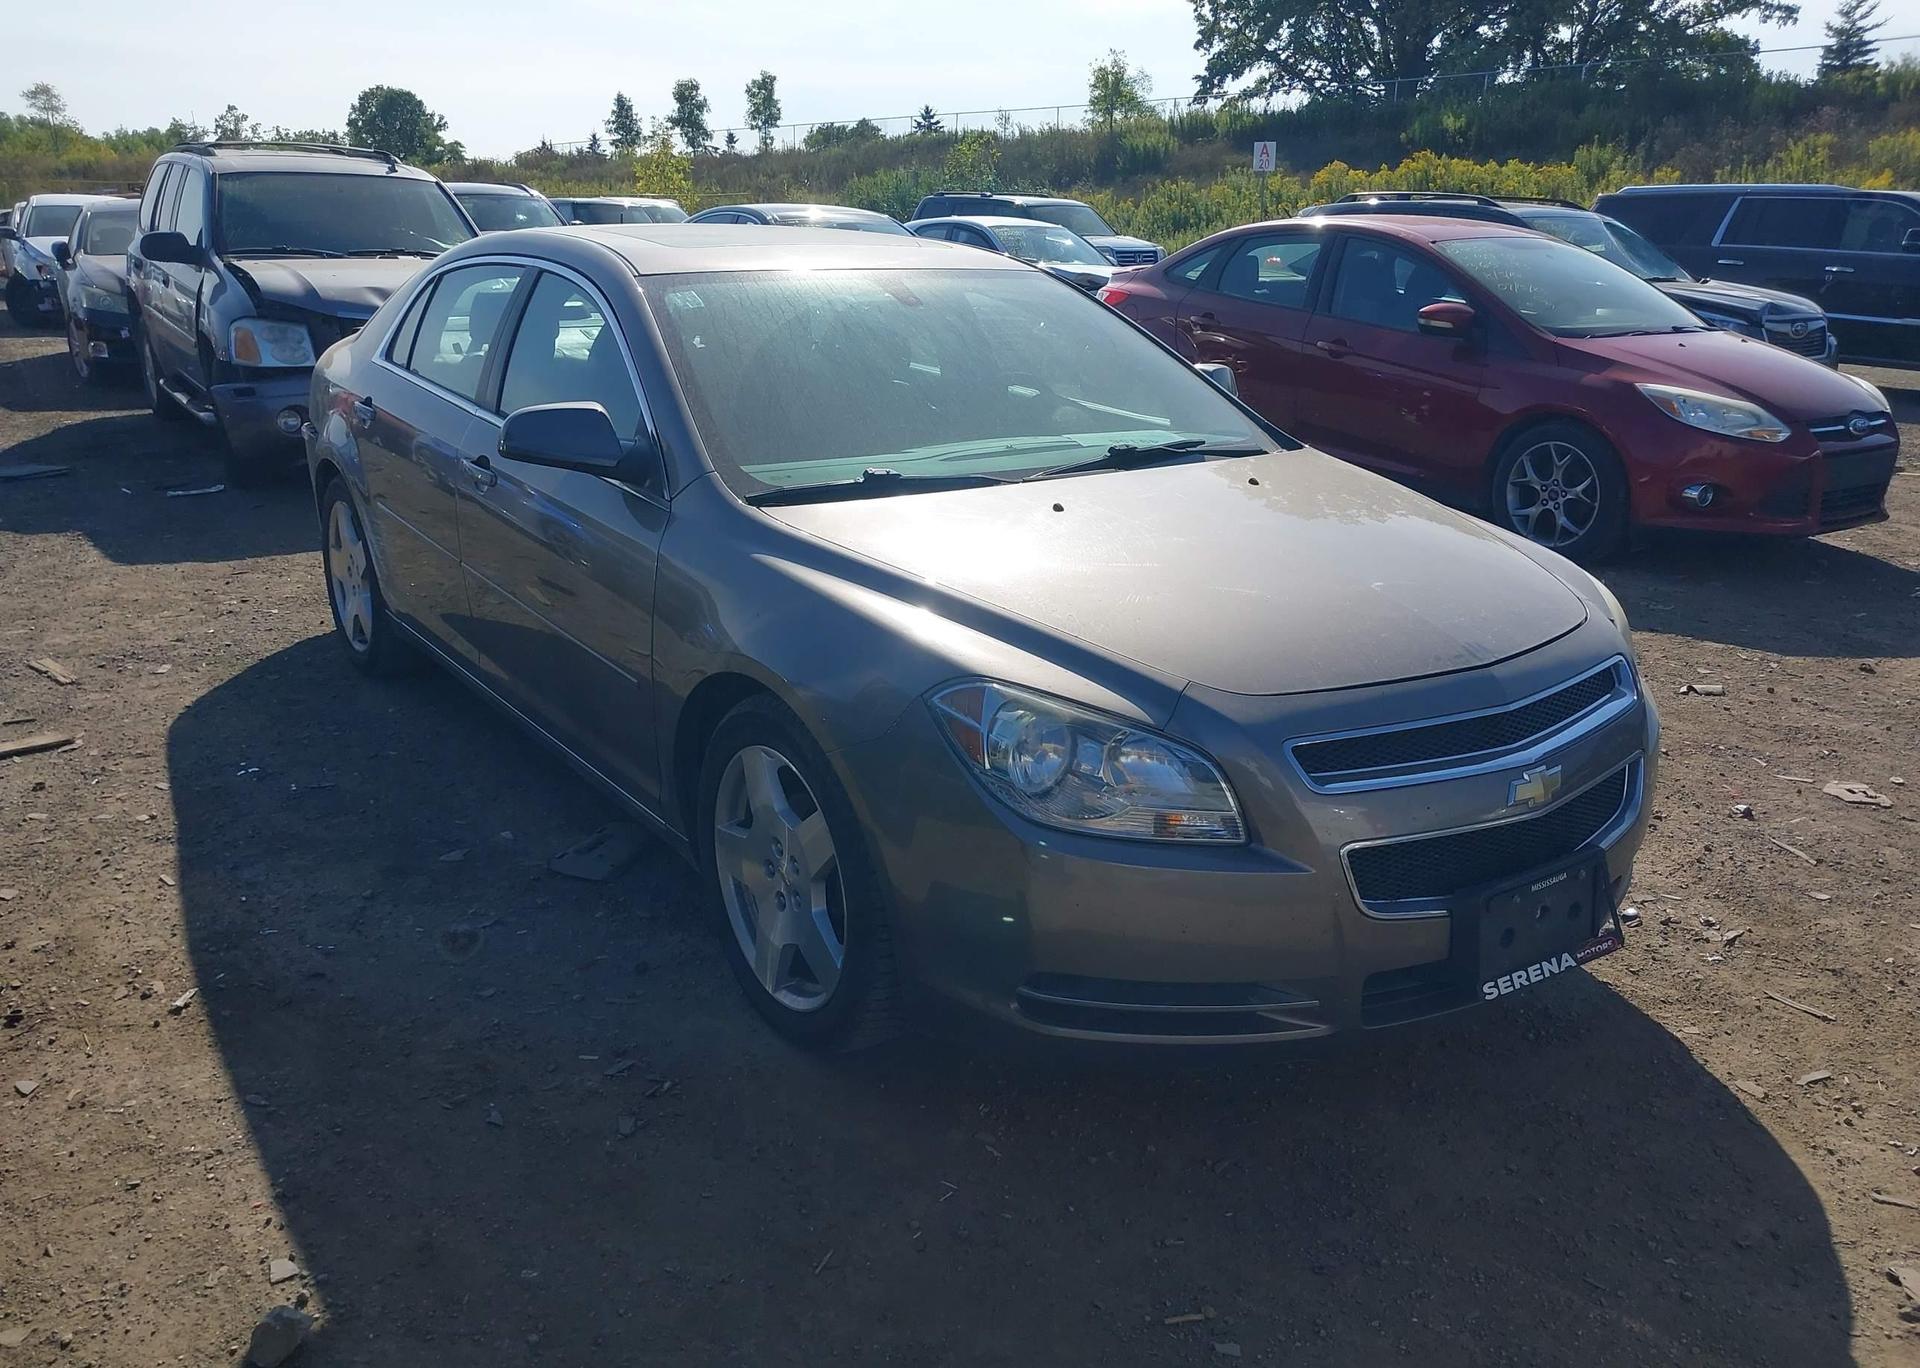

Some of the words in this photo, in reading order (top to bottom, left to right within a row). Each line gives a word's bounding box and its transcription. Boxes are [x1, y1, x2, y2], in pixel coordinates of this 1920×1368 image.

[1260, 143, 1270, 158] A
[1259, 159, 1270, 169] 20
[1531, 872, 1567, 892] MISSISSAUGA
[1482, 952, 1577, 1000] SERENA
